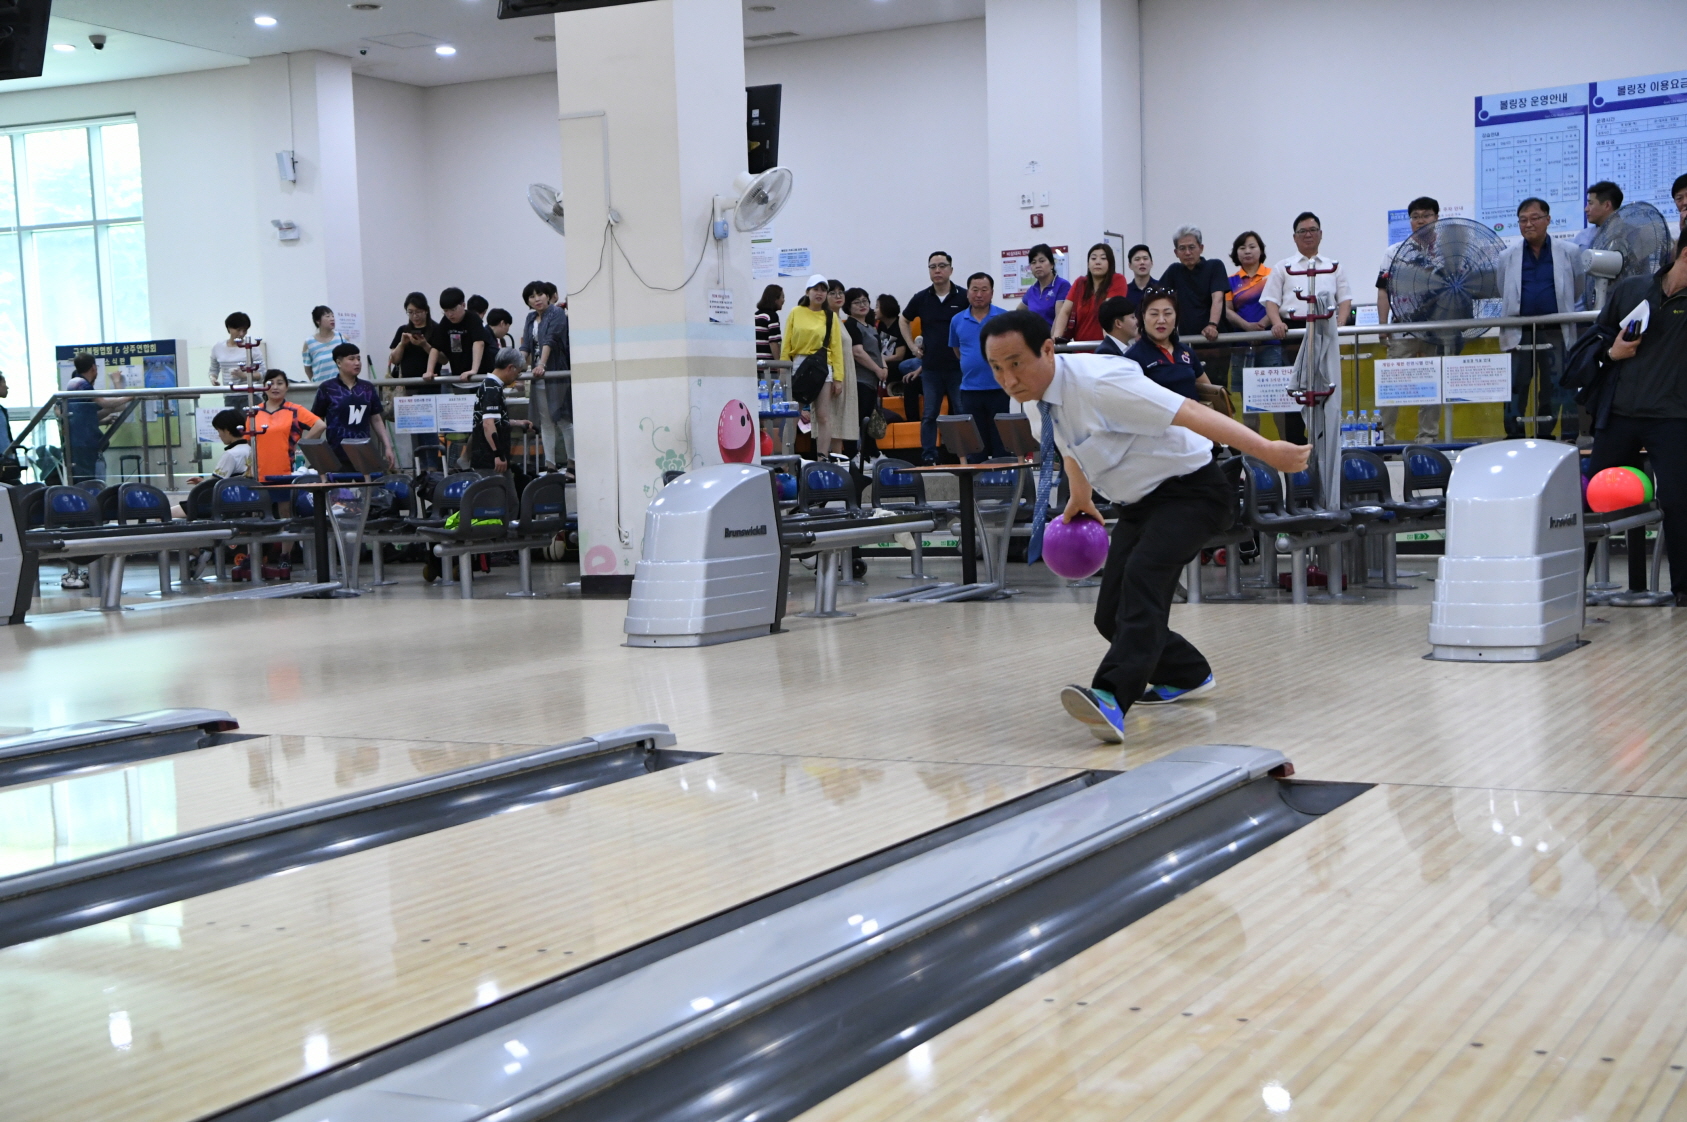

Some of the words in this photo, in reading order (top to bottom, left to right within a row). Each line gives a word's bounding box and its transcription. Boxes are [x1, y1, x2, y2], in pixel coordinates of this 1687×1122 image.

[1617, 83, 1646, 96] 볼링장
[1500, 97, 1527, 111] 볼링장
[1530, 93, 1568, 107] 운영안내
[348, 405, 367, 424] W
[725, 525, 761, 537] Brunswick
